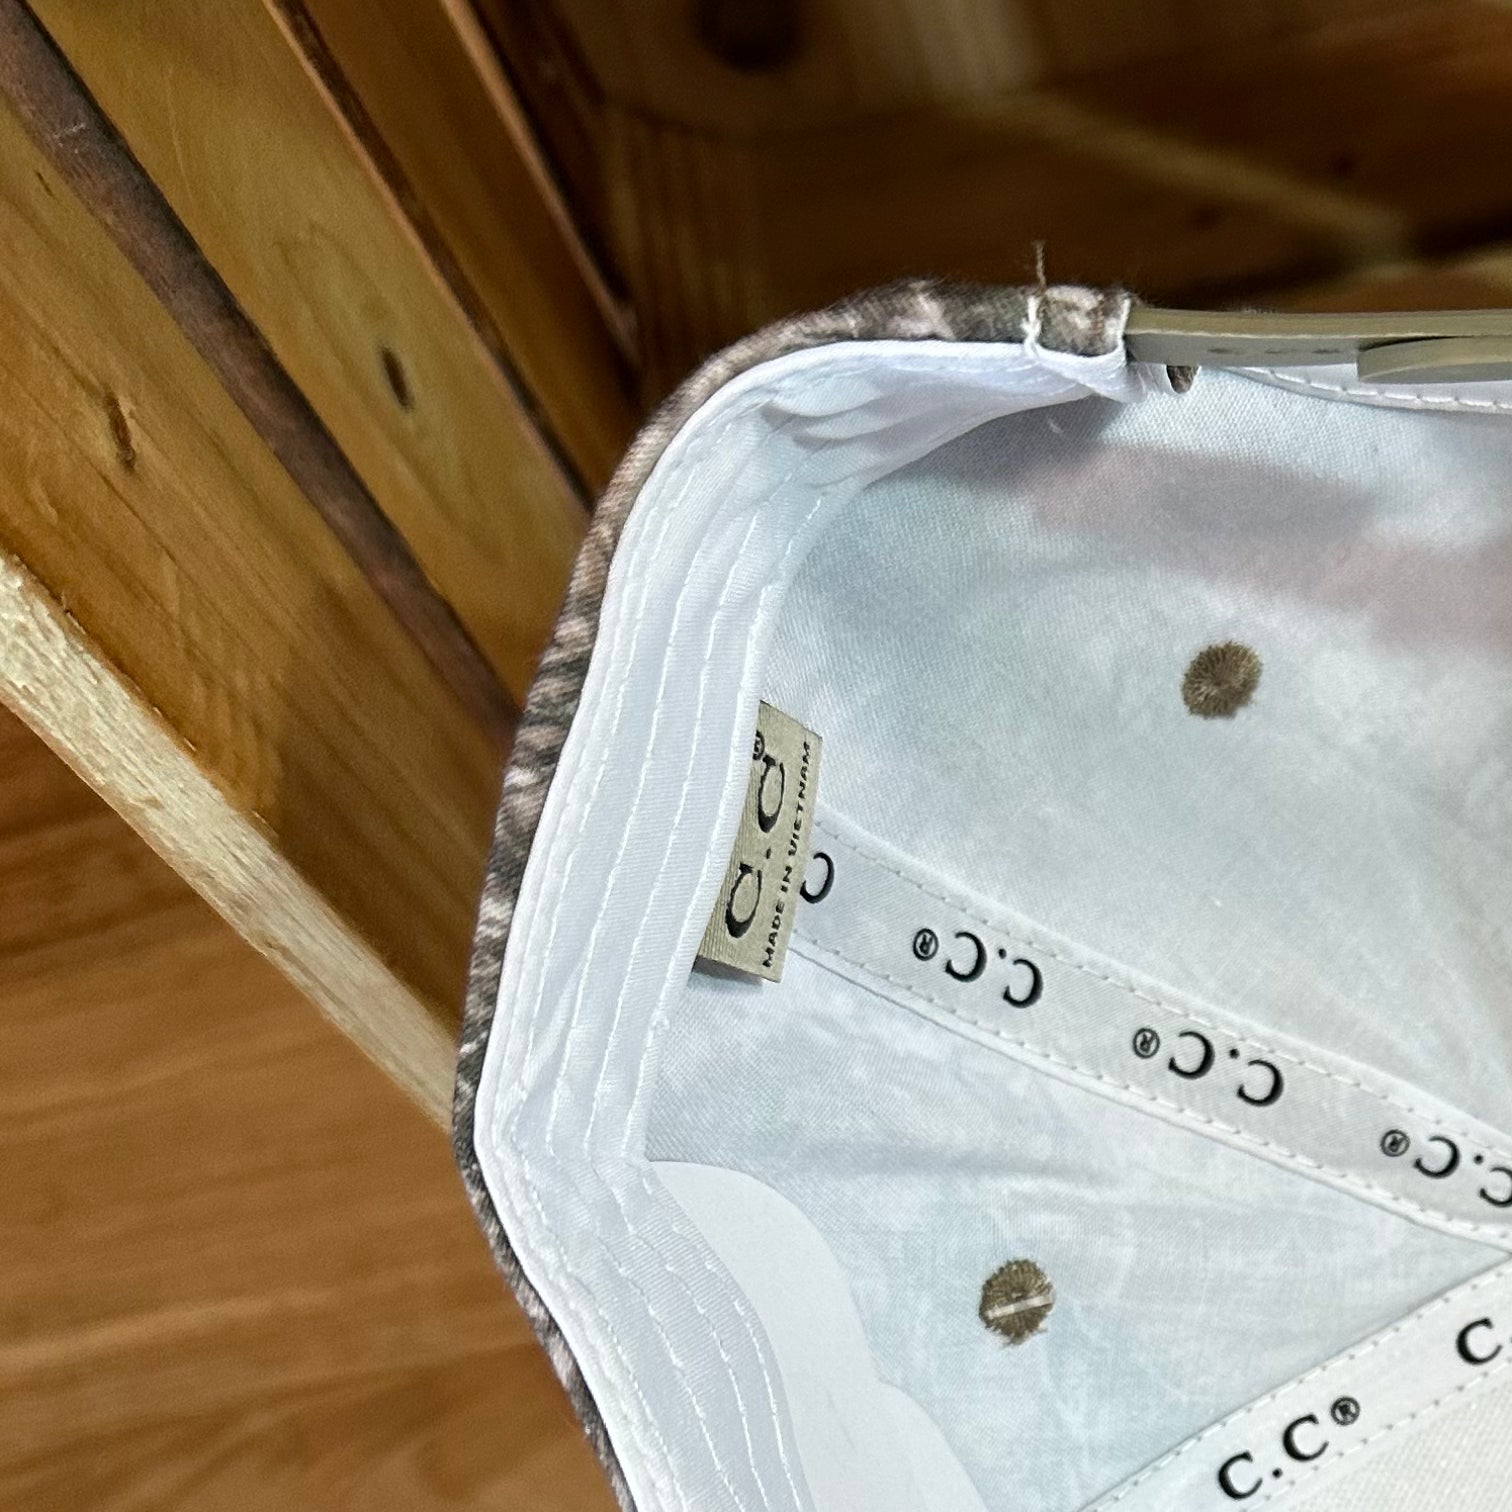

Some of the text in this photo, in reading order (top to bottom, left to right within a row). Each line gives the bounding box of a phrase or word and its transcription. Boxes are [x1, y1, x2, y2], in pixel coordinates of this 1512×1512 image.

[763, 740, 812, 969] MADE IN VIETNAM
